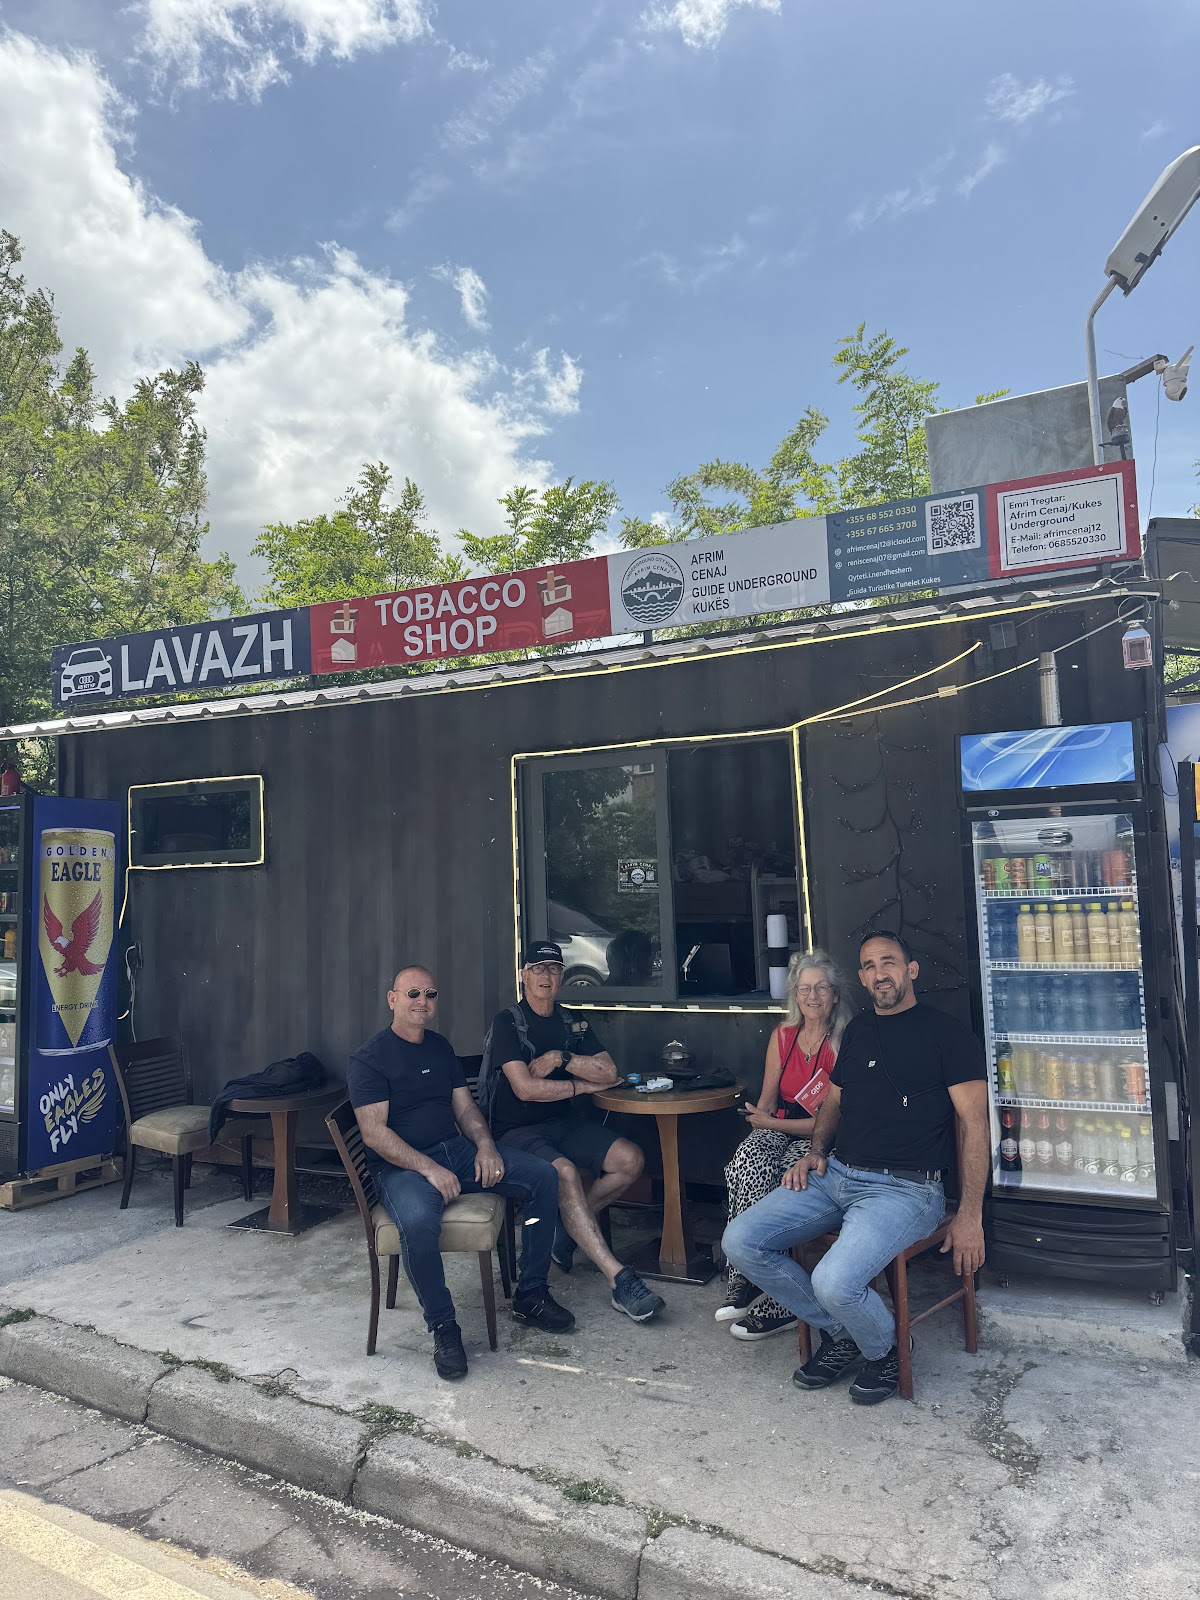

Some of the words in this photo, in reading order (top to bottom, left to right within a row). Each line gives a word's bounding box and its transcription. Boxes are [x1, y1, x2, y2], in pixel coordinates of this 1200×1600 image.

[1009, 499, 1029, 510] Emri
[1031, 495, 1065, 507] Tregtar:
[1010, 509, 1037, 521] Afrim
[1039, 499, 1103, 516] Cenaj/Kukes
[845, 514, 865, 525] +355
[866, 512, 877, 521] 68
[878, 509, 894, 519] 552
[895, 505, 917, 516] 0330
[1010, 513, 1075, 530] Underground
[846, 528, 865, 539] +355
[867, 526, 877, 535] 67
[878, 523, 895, 533] 665
[896, 520, 917, 531] 3708
[1011, 532, 1041, 544] E-Mail:
[1043, 523, 1101, 540] afrimcenaj12
[1012, 543, 1047, 554] Telefon:
[1048, 533, 1107, 549] 0685520330
[691, 549, 724, 566] AFRIM
[847, 548, 926, 567] reniscenaj07@gmail.com
[634, 565, 651, 577] AFRIM
[652, 564, 671, 574] CENAJ
[691, 566, 728, 581] CENAJ
[691, 583, 725, 598] GUIDE
[728, 568, 818, 593] UNDERGROUND
[848, 585, 867, 596] Guida
[868, 582, 895, 593] Turistike
[895, 579, 920, 589] Tunelet
[375, 578, 526, 626] TOBACCO
[693, 598, 730, 614] KUKËS
[403, 615, 497, 656] SHOP
[120, 619, 293, 692] LAVAZH
[46, 846, 107, 857] GOLDEN
[51, 861, 102, 882] EAGLE
[52, 1002, 78, 1012] ENERGY
[79, 999, 99, 1009] DRINK
[39, 1073, 74, 1115] ONLY
[44, 1067, 105, 1133] EAGLES
[49, 1114, 78, 1153] FLY
